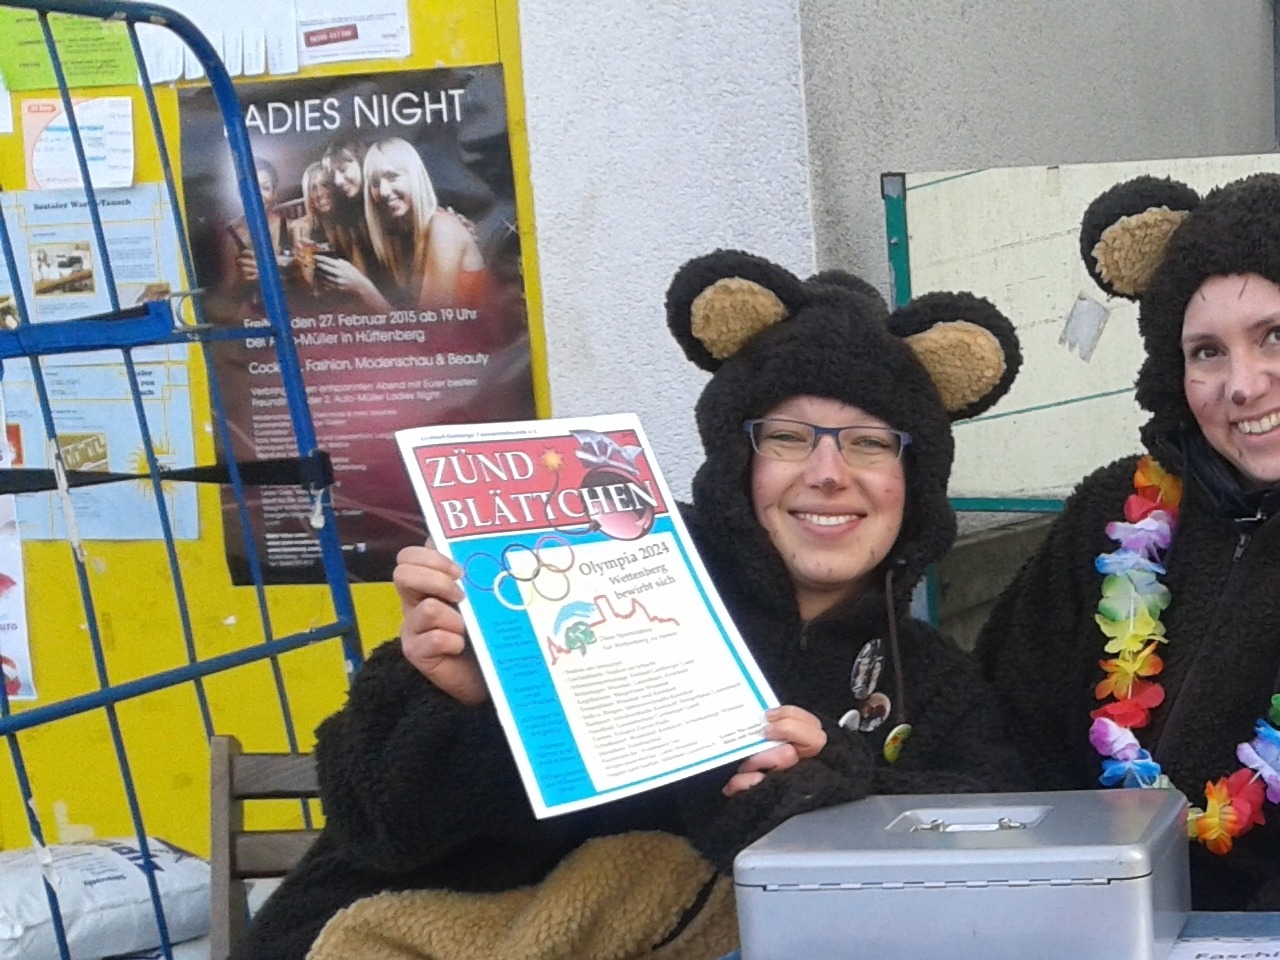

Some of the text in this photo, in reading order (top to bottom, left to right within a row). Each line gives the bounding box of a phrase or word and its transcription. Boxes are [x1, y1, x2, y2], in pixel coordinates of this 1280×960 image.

[224, 89, 465, 137] ADIES NIGHT
[290, 316, 317, 328] den
[319, 314, 335, 327] 27.
[338, 312, 387, 327] Februar
[389, 310, 417, 324] 2015
[419, 311, 438, 323] ab
[440, 308, 454, 322] 19
[456, 308, 478, 321] Uhr
[341, 331, 353, 343] in
[356, 328, 426, 344] Hüttenberg
[355, 355, 434, 369] Modenschau
[436, 353, 445, 365] &
[447, 352, 490, 367] Beauty
[425, 448, 535, 487] ZÜND
[441, 480, 659, 531] BLÄTTCHEN
[578, 541, 670, 578] Olympia 2024
[608, 563, 669, 588] Wettenberg
[659, 575, 676, 592] sich
[0, 623, 18, 631] uro
